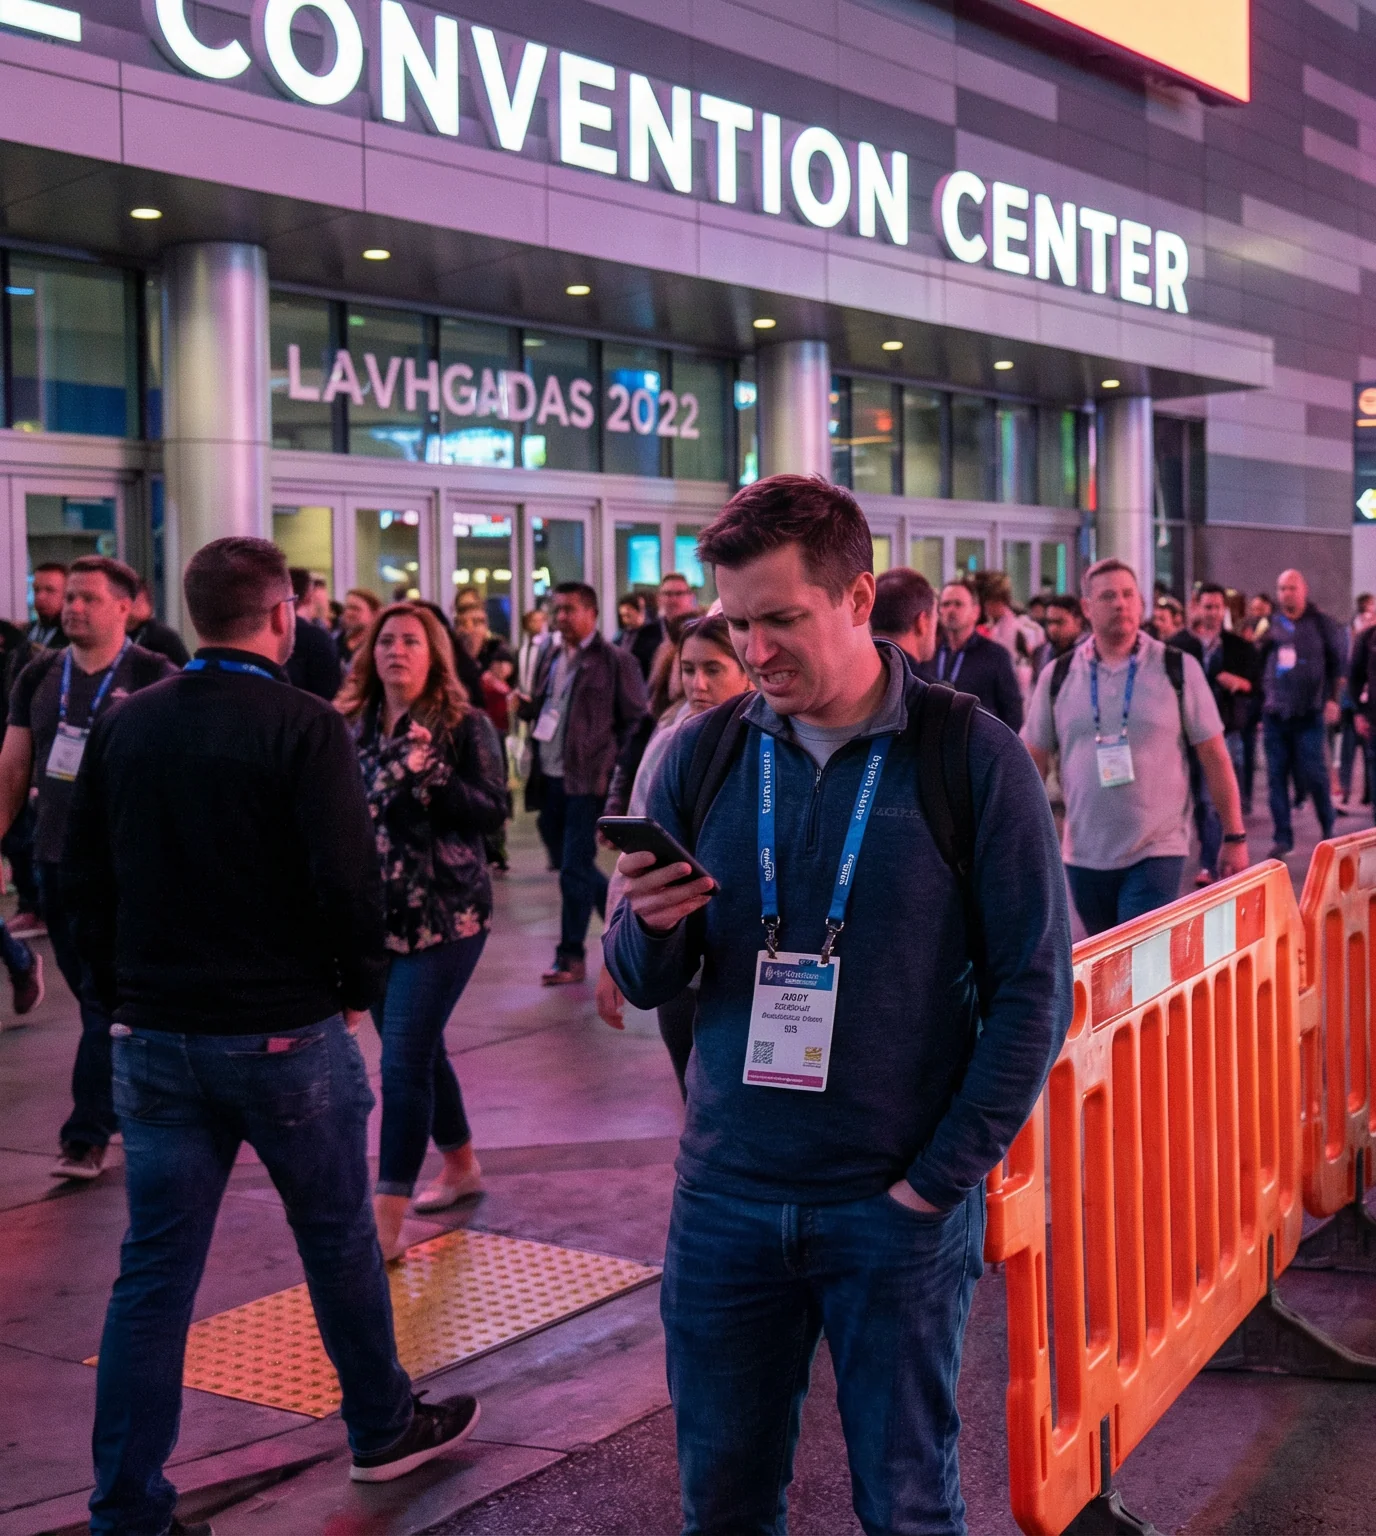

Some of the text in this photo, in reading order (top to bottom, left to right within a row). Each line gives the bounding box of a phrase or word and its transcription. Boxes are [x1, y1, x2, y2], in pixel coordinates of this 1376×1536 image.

[155, 0, 1189, 314] CONVENTION CENTER
[606, 384, 700, 440] 2022
